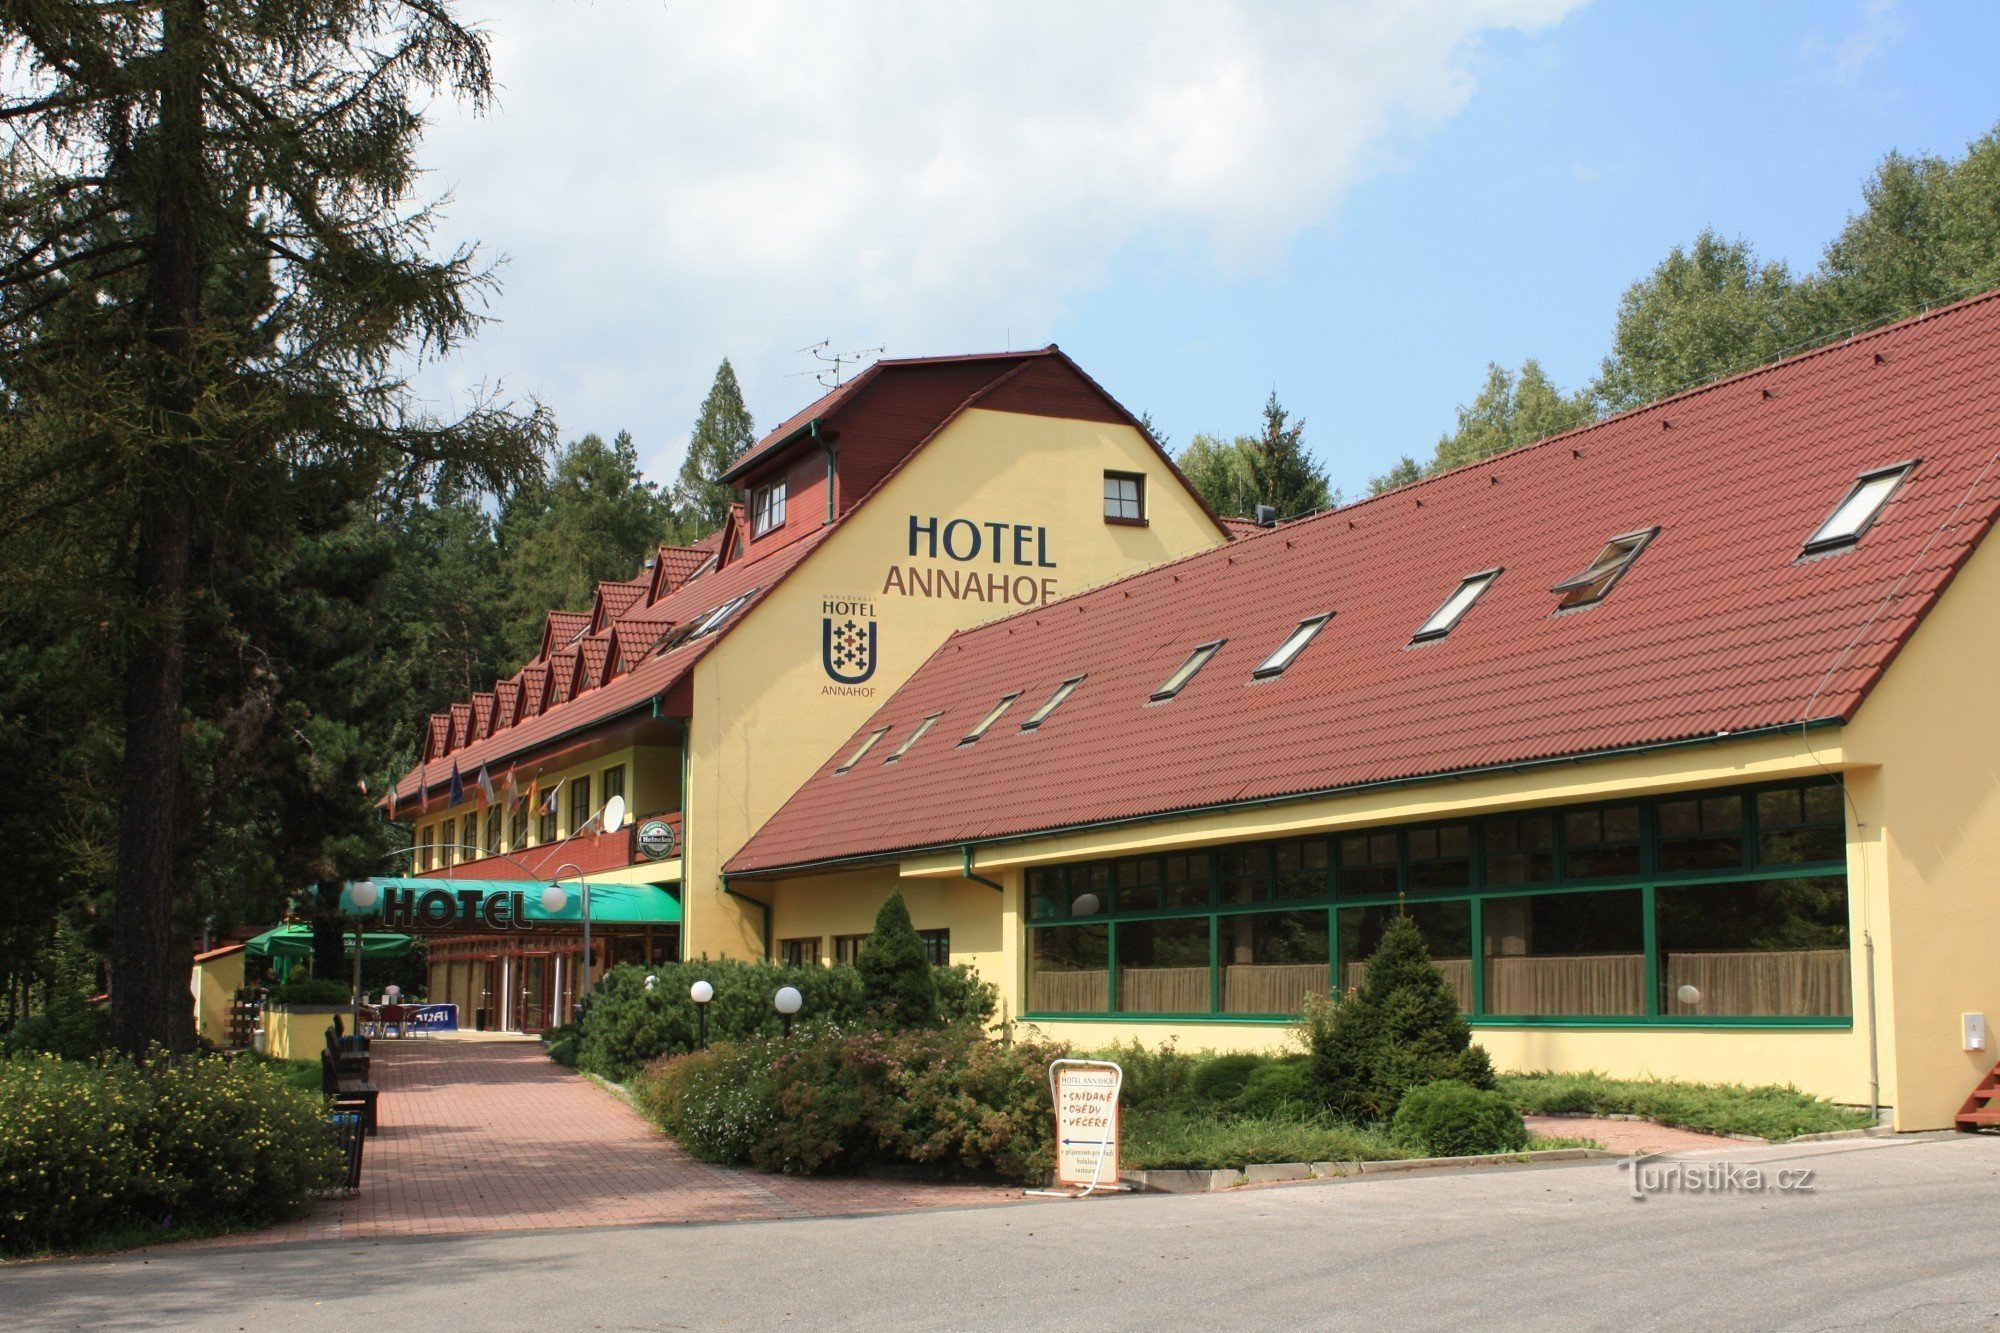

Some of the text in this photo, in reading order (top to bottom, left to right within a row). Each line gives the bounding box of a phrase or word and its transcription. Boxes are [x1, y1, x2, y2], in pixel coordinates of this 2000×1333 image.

[908, 515, 1057, 568] HOTEL
[882, 565, 1058, 606] ANNAHOF
[822, 601, 877, 617] HOTEL
[821, 685, 876, 698] ANNAHOF
[383, 887, 534, 930] HOTEL
[1061, 1076, 1114, 1085] HOTEL ANNAHOF
